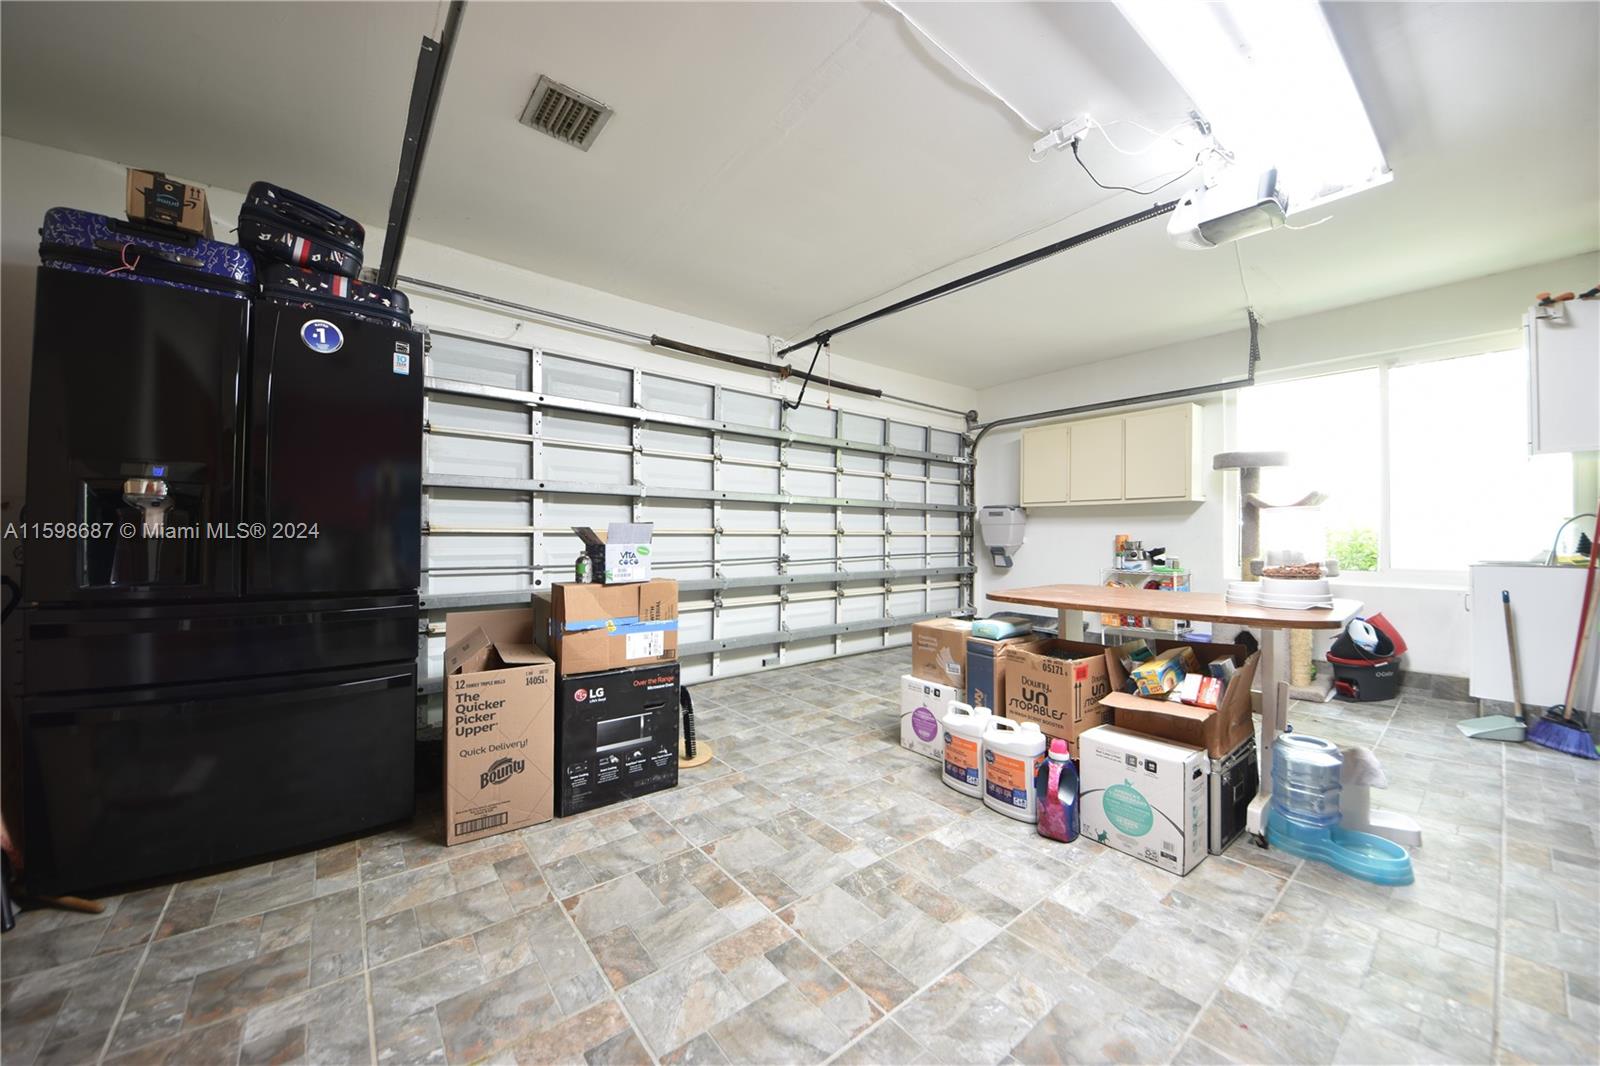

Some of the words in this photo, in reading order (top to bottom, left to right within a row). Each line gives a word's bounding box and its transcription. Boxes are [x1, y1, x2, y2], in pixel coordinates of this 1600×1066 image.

[620, 551, 636, 559] VITA
[1042, 663, 1064, 676] 05171
[455, 679, 466, 690] 12
[526, 675, 545, 686] 14051
[633, 679, 648, 687] Over
[1021, 675, 1051, 694] Downy
[455, 693, 480, 703] The
[589, 687, 605, 699] LG
[455, 700, 506, 715] Quicker
[455, 712, 496, 726] Picker
[1042, 719, 1065, 730] BOOSTER
[455, 723, 496, 738] Upper
[459, 746, 487, 758] Quick
[488, 739, 529, 753] Delivery!
[480, 759, 525, 790] Bounty
